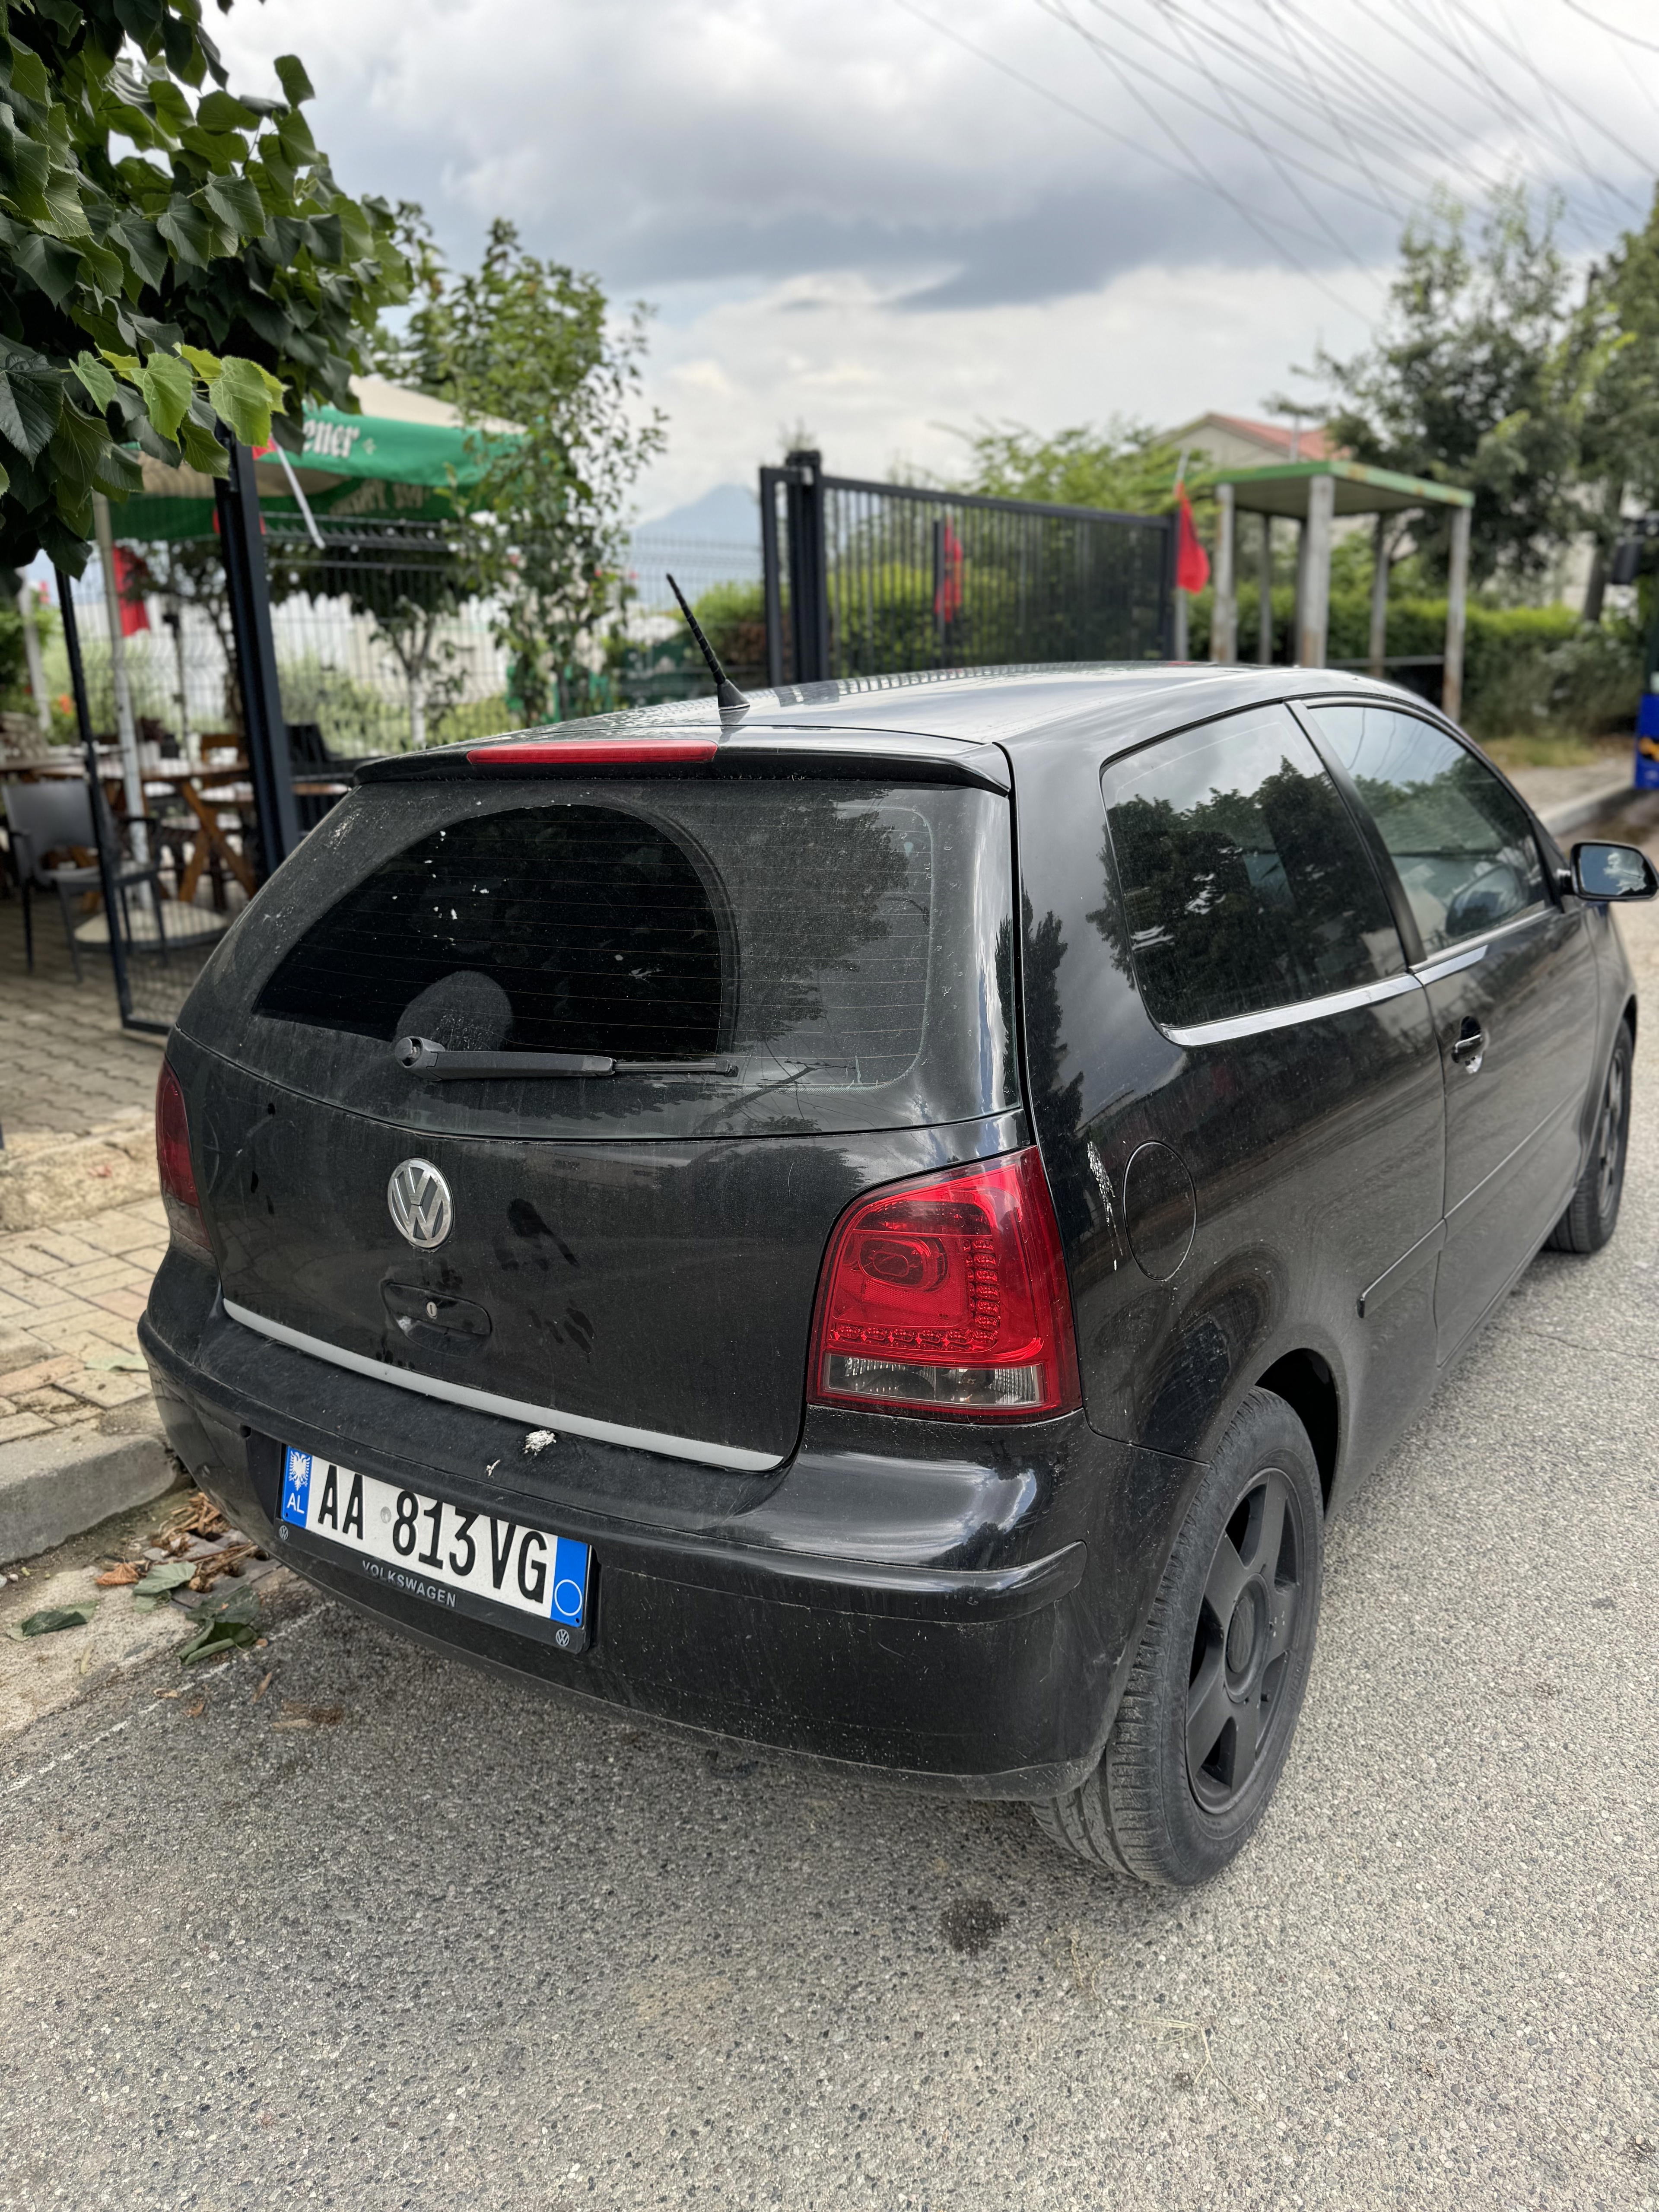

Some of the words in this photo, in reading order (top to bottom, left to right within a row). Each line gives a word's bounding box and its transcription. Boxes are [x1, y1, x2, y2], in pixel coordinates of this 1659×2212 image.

[287, 1492, 305, 1514] AL
[318, 1464, 364, 1540] AA
[362, 1560, 456, 1607] VOLKSWAGEN
